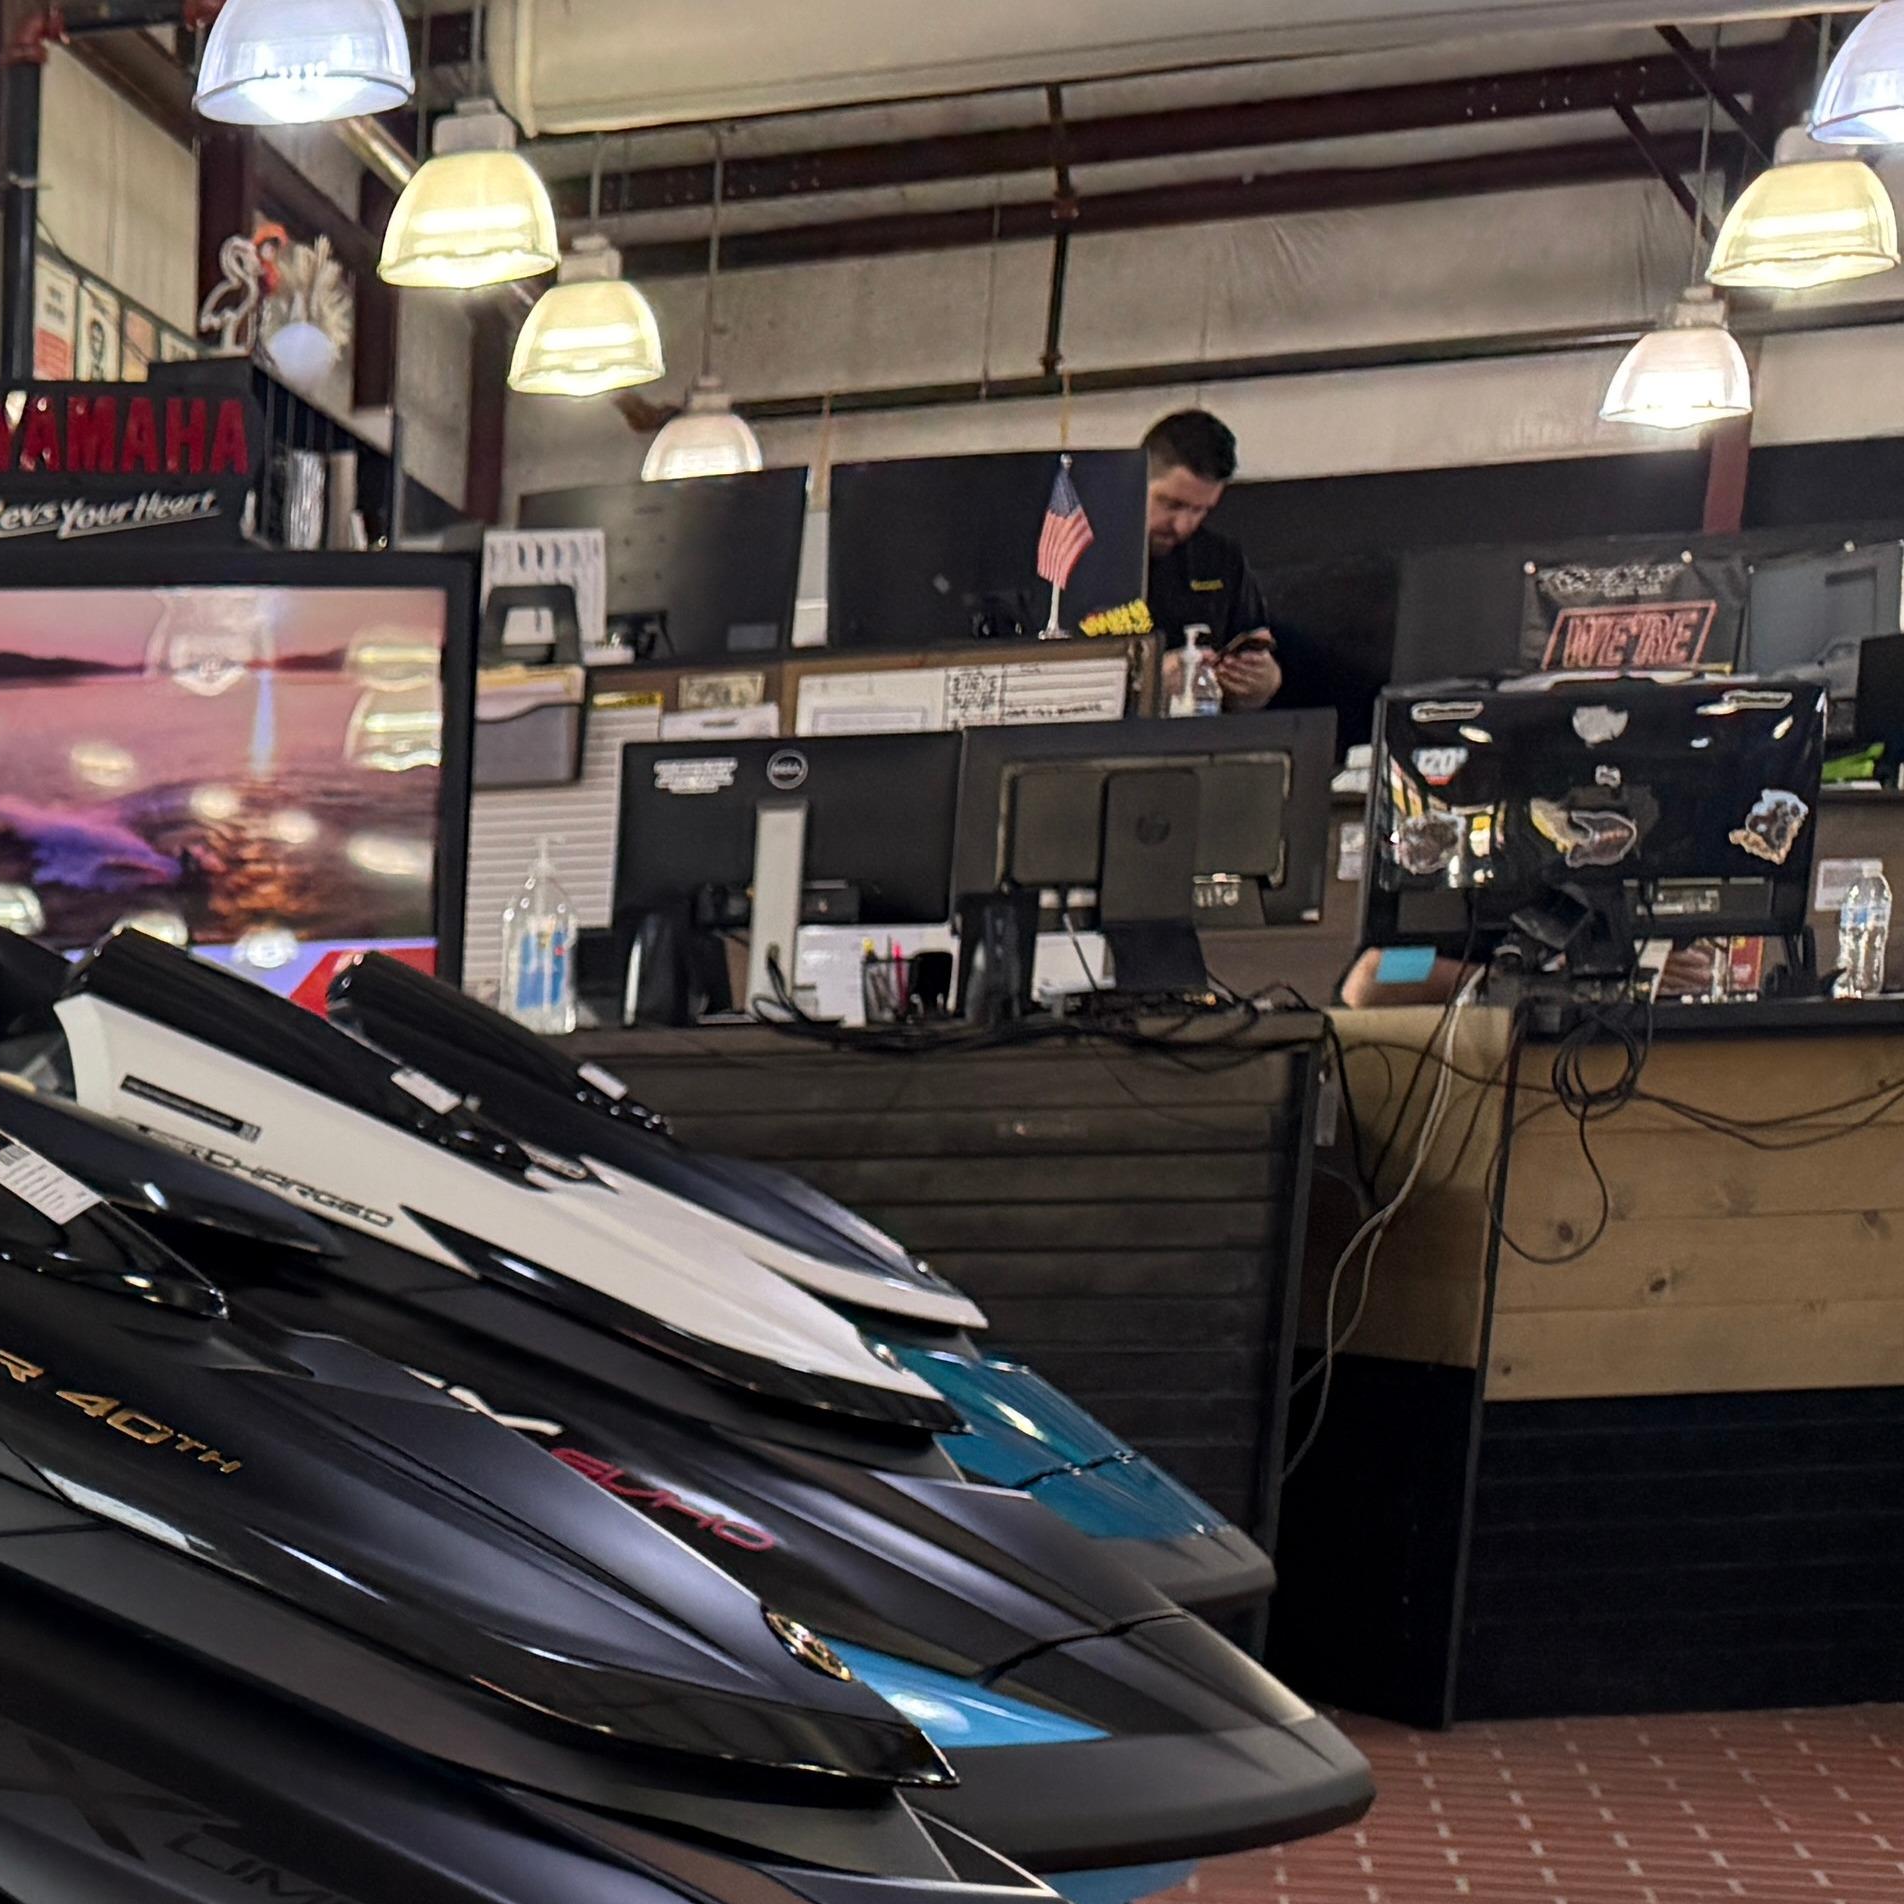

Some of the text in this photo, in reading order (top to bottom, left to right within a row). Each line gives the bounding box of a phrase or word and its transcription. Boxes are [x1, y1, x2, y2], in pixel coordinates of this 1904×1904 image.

[56, 496, 135, 541] Your
[133, 490, 222, 524] Heart
[1562, 611, 1700, 668] WE'RE
[55, 1388, 241, 1475] 40TH
